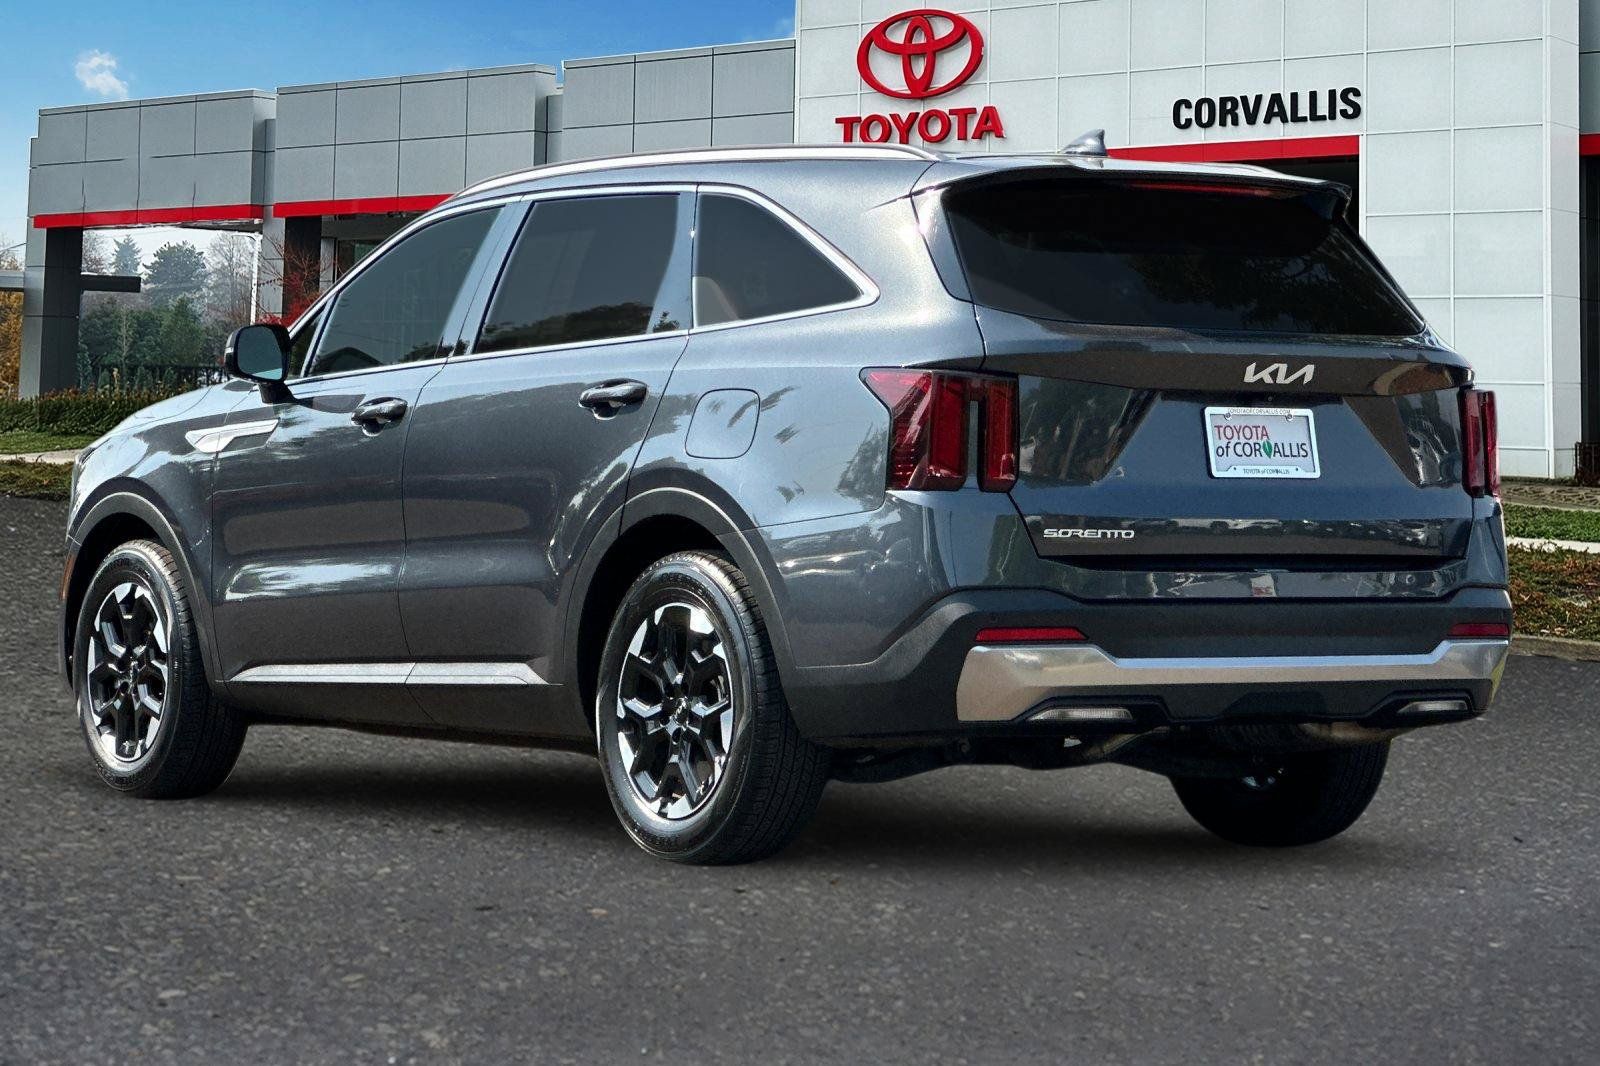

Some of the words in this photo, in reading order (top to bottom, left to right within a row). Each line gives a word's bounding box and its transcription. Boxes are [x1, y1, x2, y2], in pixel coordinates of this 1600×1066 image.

[1172, 87, 1362, 129] CORVALLIS
[835, 105, 1006, 145] TOYOTA
[1243, 362, 1315, 385] KIA
[1214, 425, 1270, 440] TOYOTA
[1216, 442, 1231, 457] of
[1043, 528, 1135, 539] SORENTO
